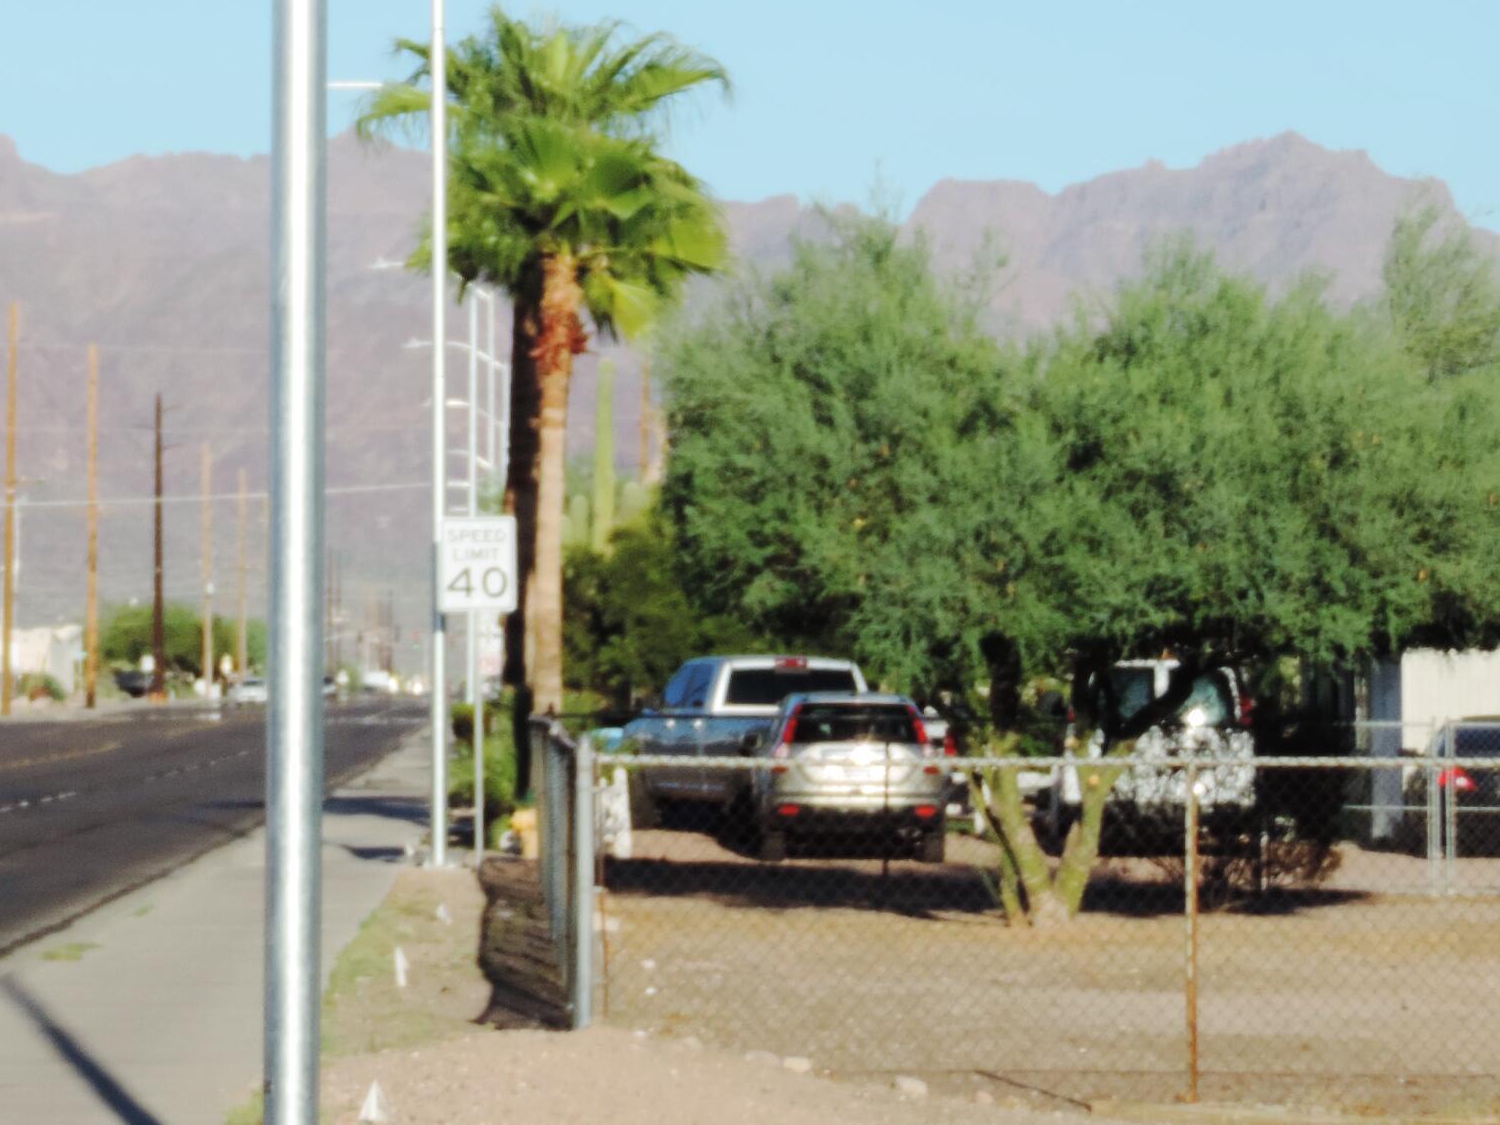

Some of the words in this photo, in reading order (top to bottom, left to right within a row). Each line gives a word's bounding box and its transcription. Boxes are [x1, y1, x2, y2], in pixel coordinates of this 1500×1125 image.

[447, 528, 507, 543] SPEED
[453, 547, 501, 562] LIMIT
[447, 567, 509, 598] 40
